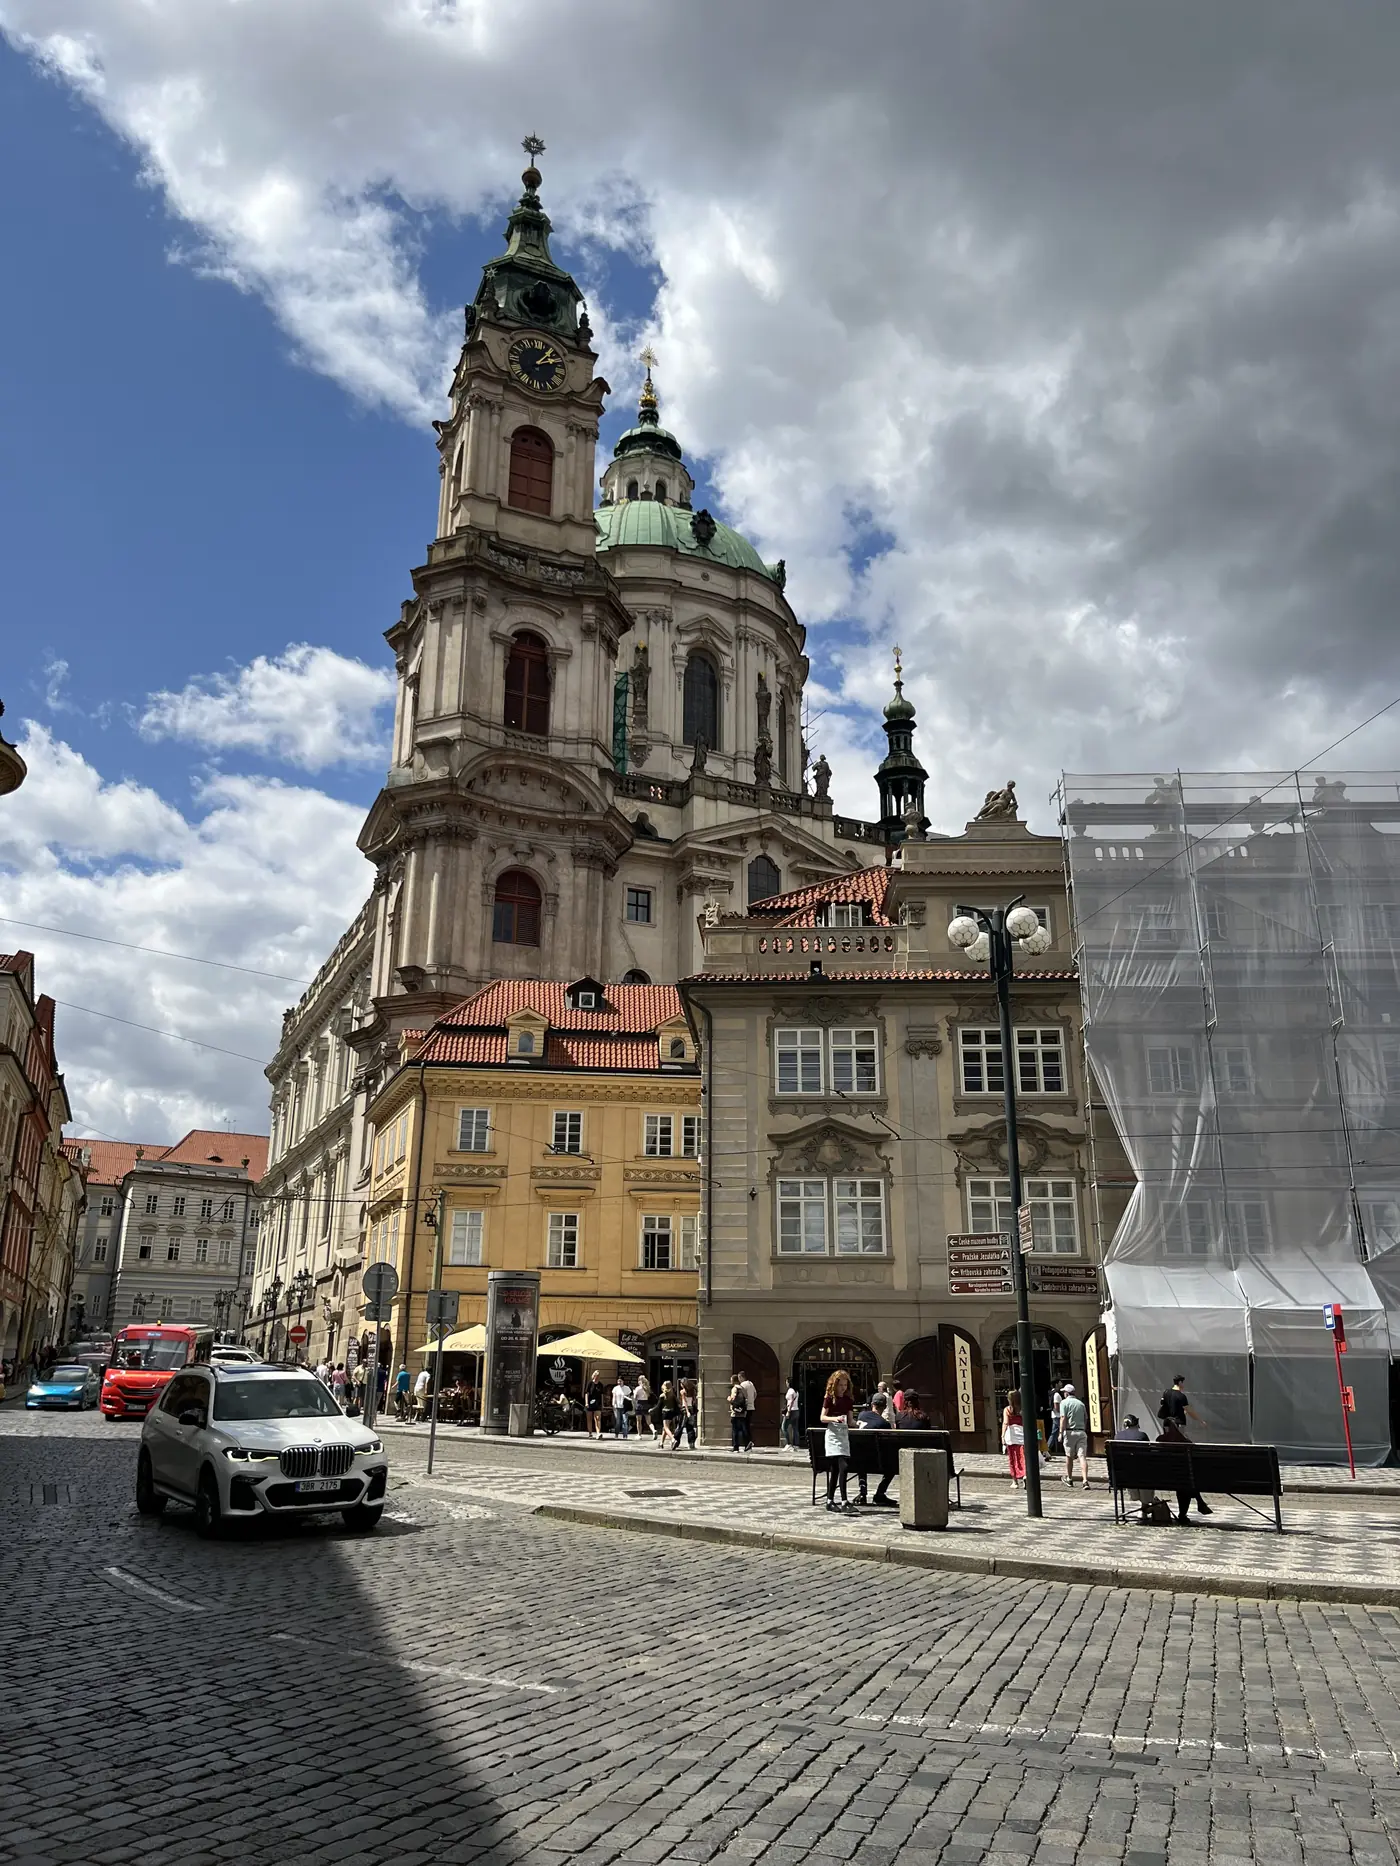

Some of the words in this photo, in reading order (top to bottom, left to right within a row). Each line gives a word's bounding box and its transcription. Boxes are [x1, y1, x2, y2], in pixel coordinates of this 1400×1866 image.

[987, 1237, 999, 1245] hudby
[962, 1252, 979, 1260] Pražské
[960, 1268, 982, 1276] Vrtbovská
[983, 1268, 1001, 1276] zahrada
[1068, 1283, 1086, 1291] zahrada
[958, 1345, 971, 1427] ANTIQUE
[1088, 1344, 1098, 1427] ANTIQUE
